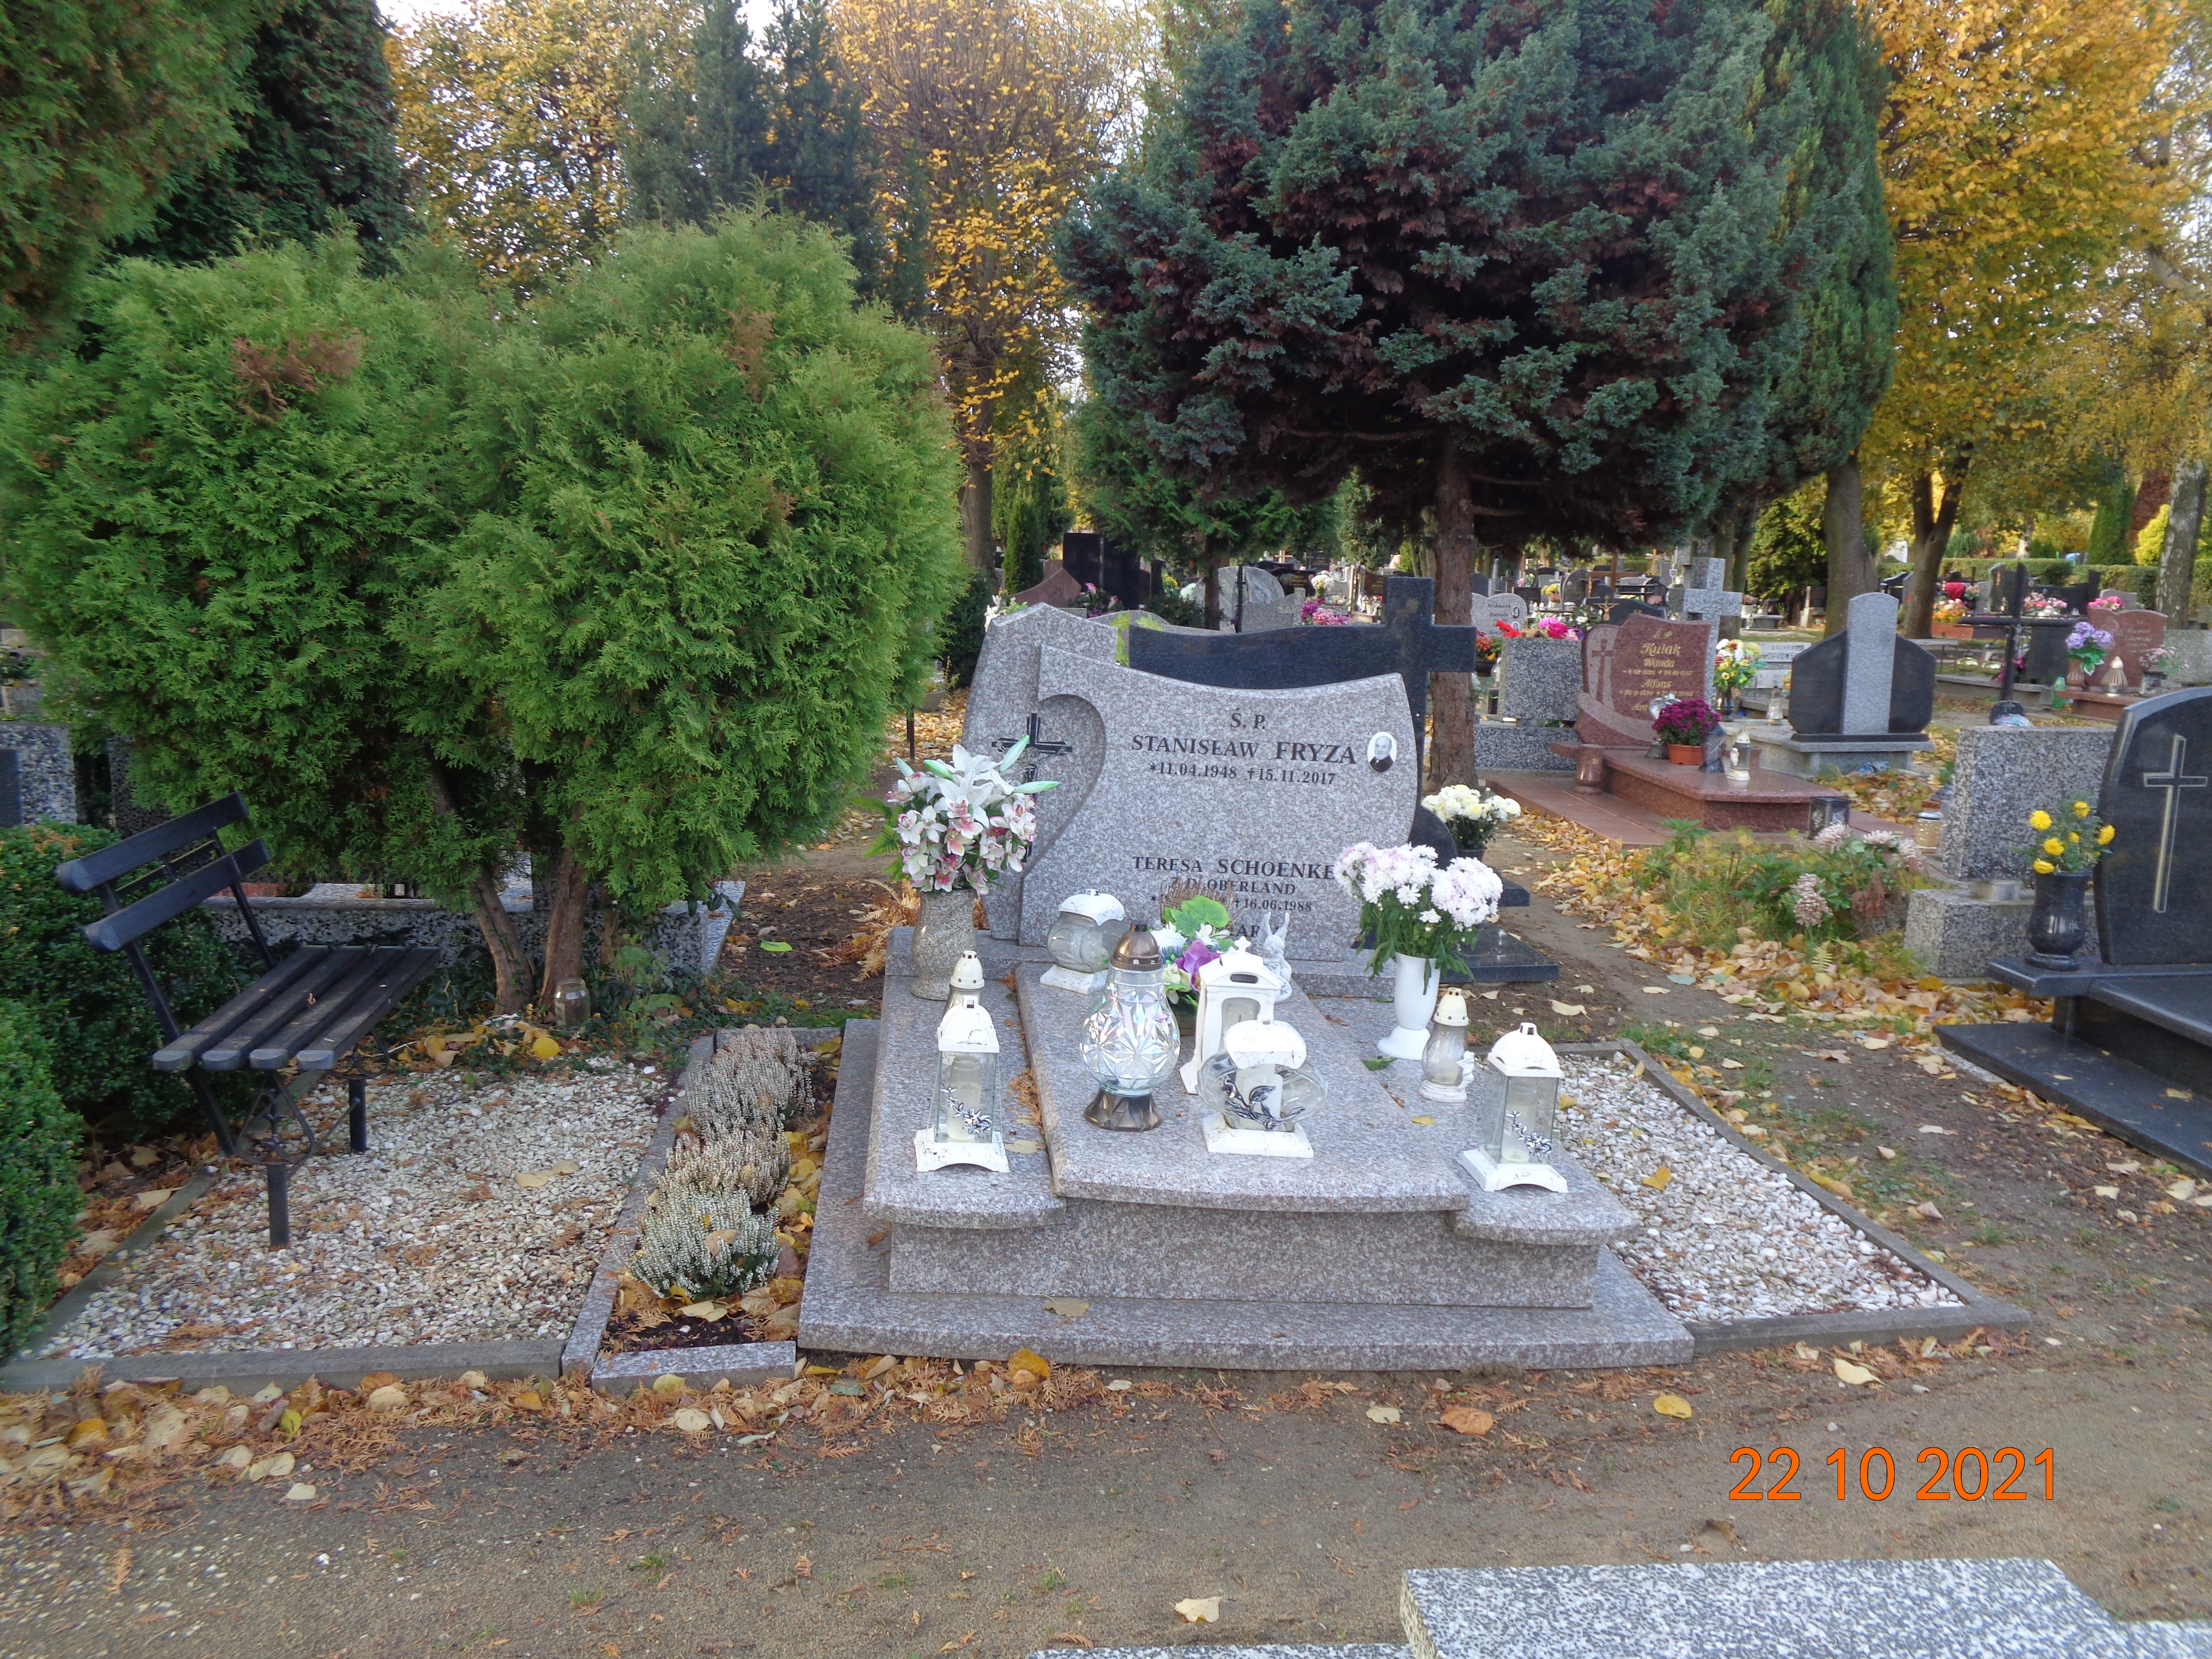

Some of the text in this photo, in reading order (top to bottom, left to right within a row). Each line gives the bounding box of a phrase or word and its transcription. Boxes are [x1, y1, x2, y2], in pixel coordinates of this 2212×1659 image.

[1641, 642, 1681, 657] Kulak
[1641, 679, 1672, 689] Alfons
[1231, 708, 1265, 729] Ś. P.
[1131, 735, 1357, 764] STANISŁAW FRYZA
[1133, 856, 1335, 880] TERESA SCHOENKE
[1207, 879, 1295, 894] OBERLAND
